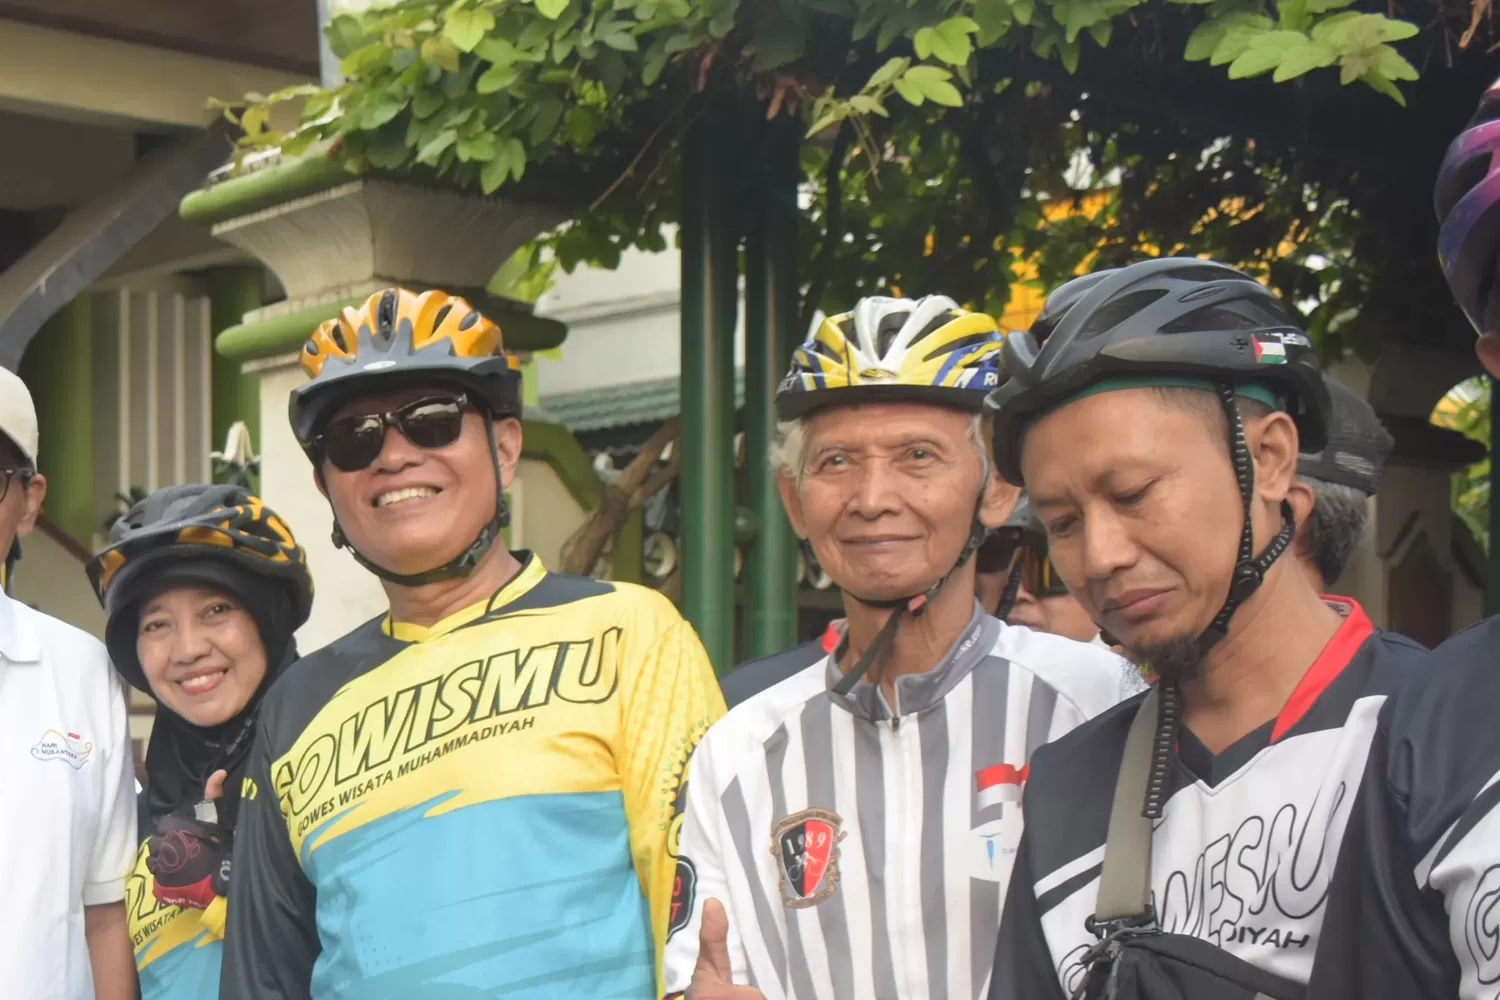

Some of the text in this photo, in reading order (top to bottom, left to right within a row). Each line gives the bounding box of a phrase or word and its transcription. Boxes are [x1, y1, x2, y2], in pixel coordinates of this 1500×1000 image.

[297, 716, 536, 838] GOWES WISATA MUHAMMADIYAH
[786, 831, 827, 855] 1989
